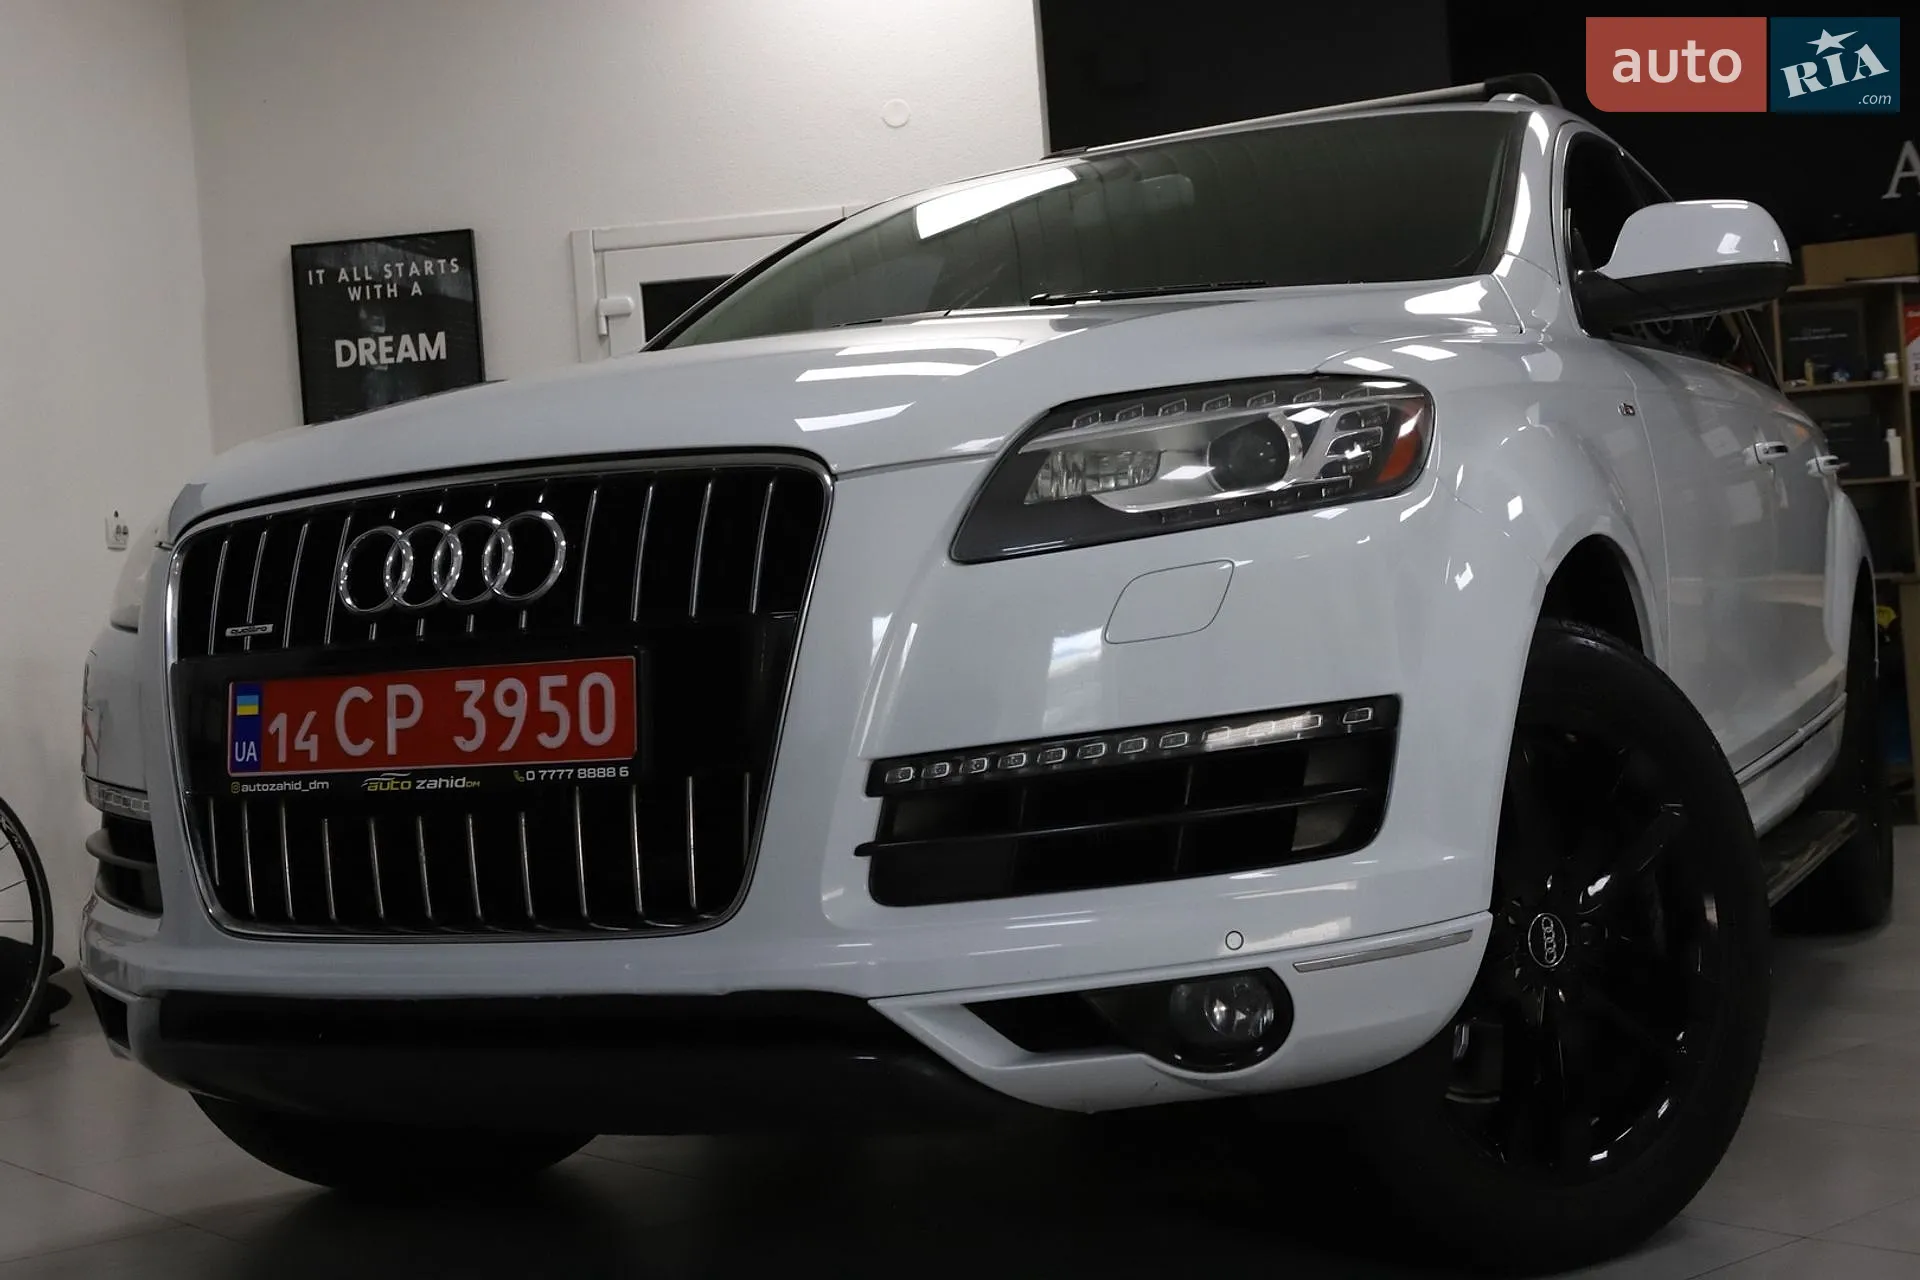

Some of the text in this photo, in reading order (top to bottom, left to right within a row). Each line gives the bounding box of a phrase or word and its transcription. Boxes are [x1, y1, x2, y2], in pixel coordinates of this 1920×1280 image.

[308, 258, 460, 286] IT ALL STARTS
[348, 281, 423, 301] WITH A
[334, 331, 447, 368] DREAM
[268, 671, 616, 763] 14 CP 3950
[234, 740, 258, 763] UA
[367, 777, 412, 792] auto
[525, 766, 629, 781] 0 7777 8888 6
